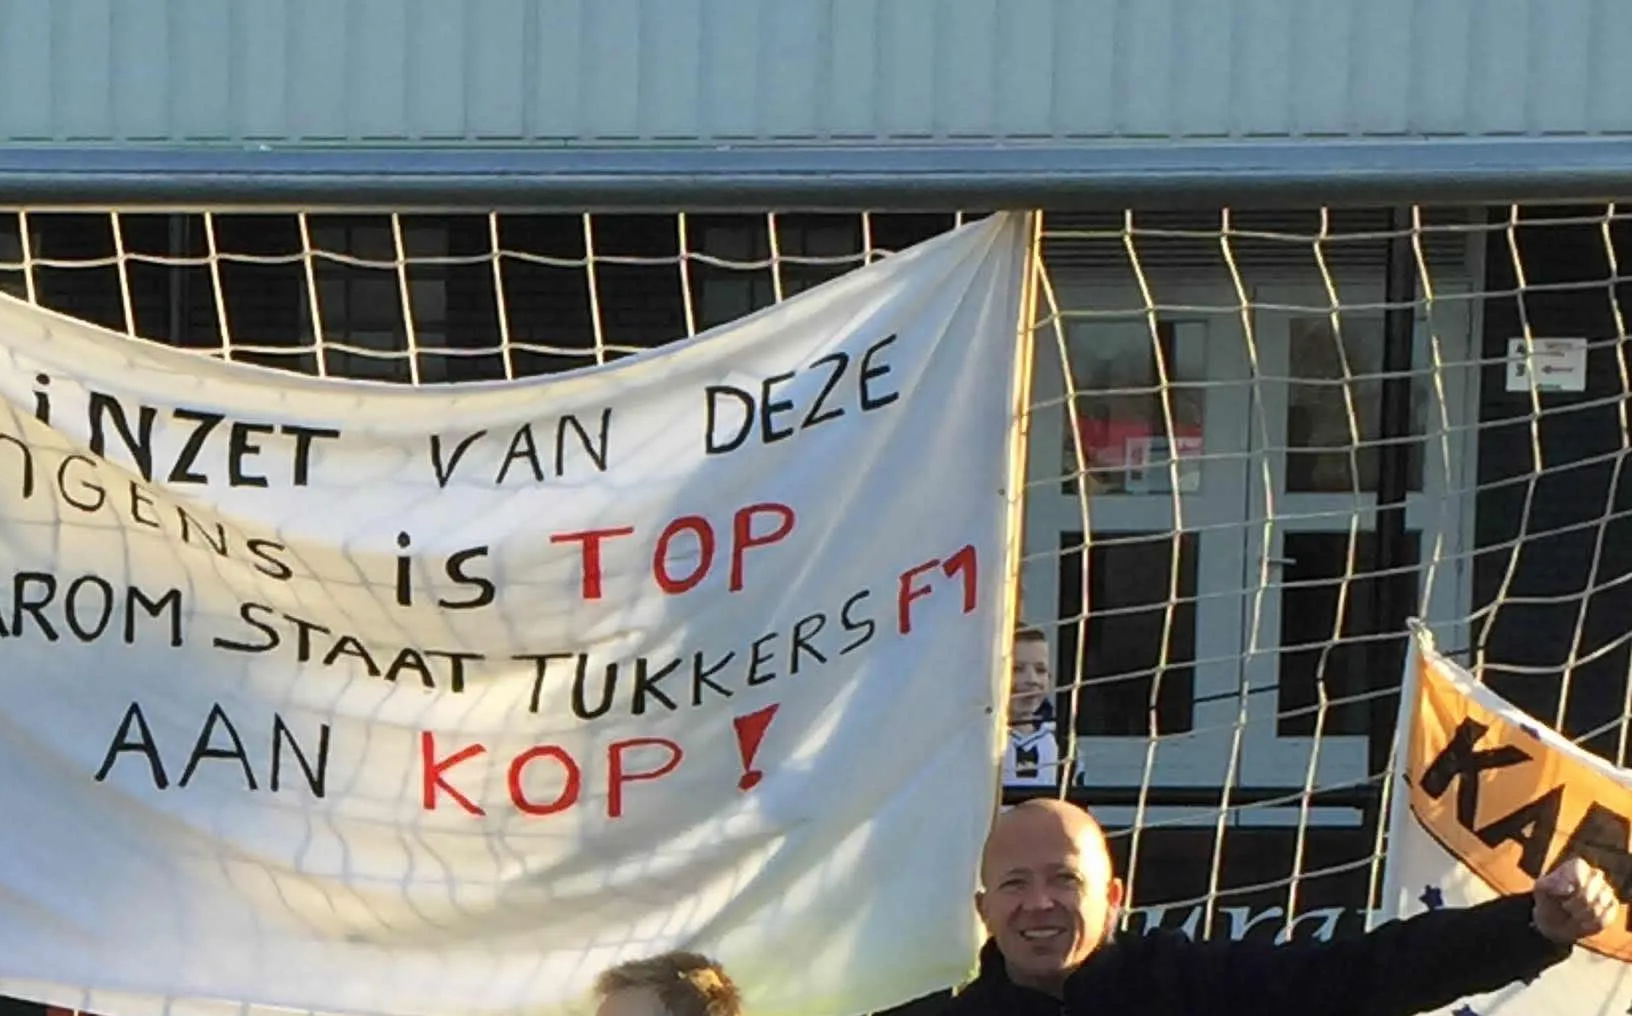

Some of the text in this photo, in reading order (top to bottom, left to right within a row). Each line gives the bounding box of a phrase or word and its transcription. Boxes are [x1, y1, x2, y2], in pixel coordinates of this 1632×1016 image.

[429, 408, 613, 488] VAN
[704, 334, 900, 455] DEZE
[549, 502, 796, 600] TOP
[212, 603, 486, 693] STAAT
[511, 588, 876, 720] TUKKERS
[896, 542, 978, 635] F1
[94, 700, 331, 799] AAN
